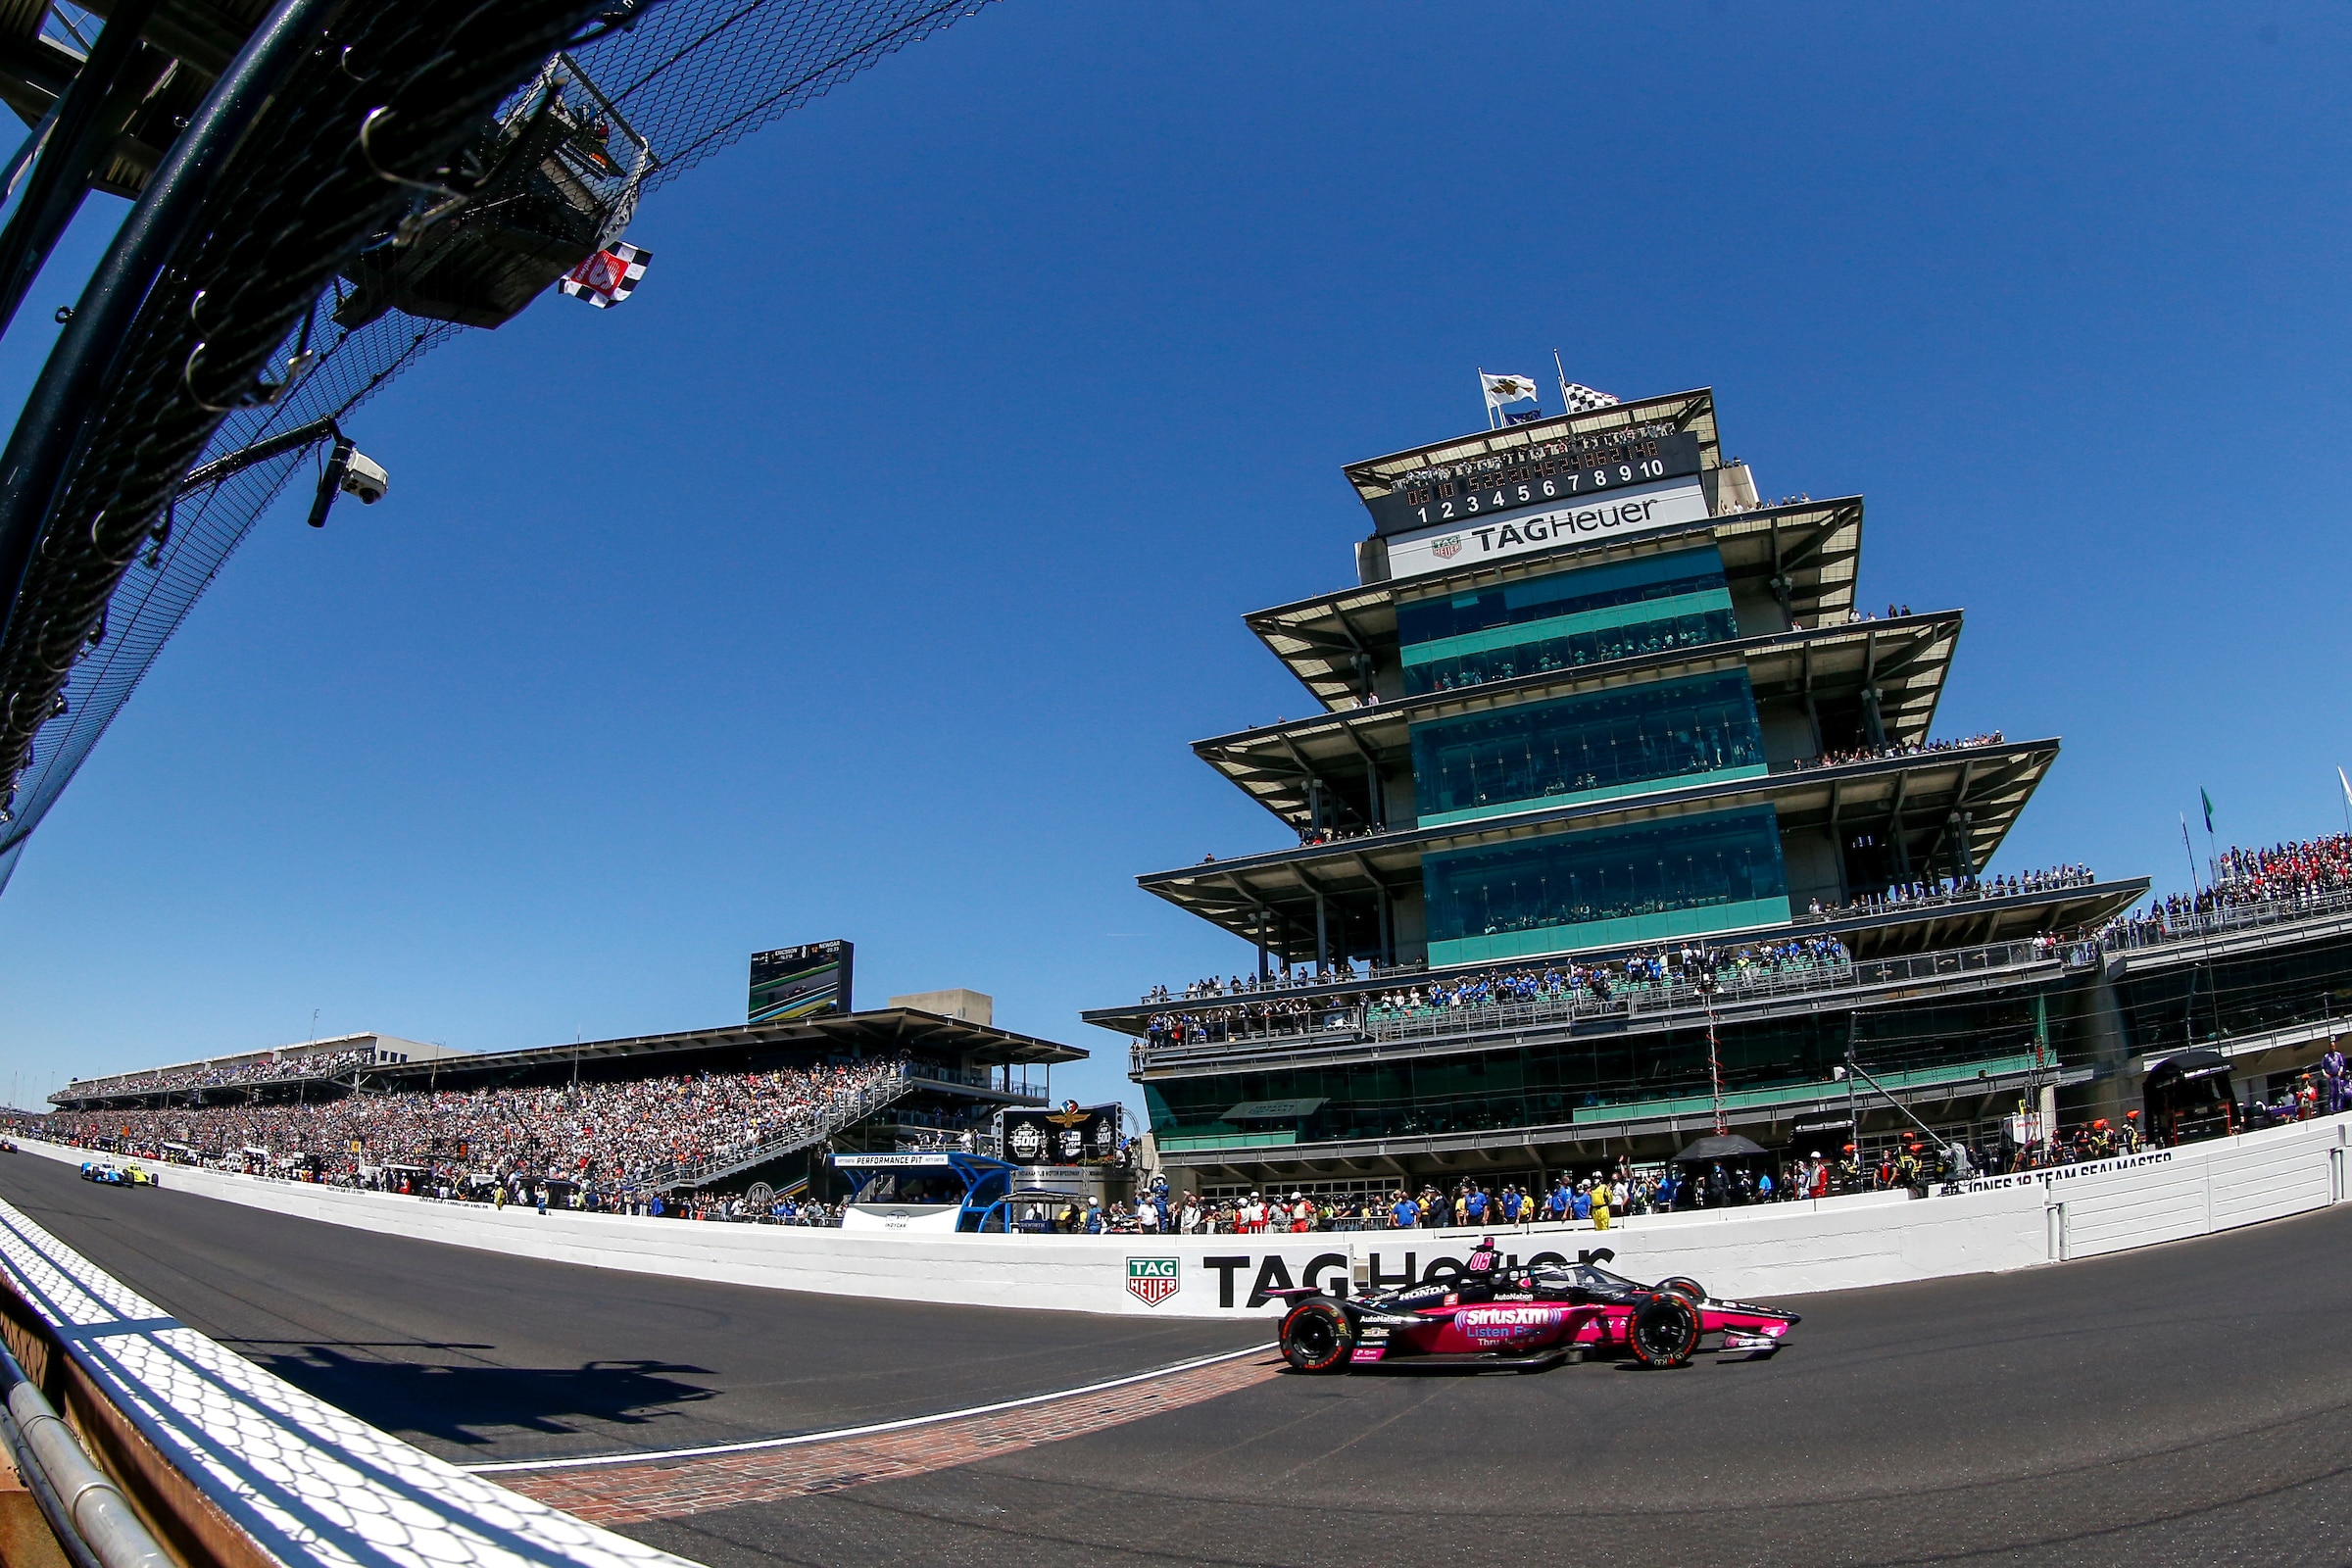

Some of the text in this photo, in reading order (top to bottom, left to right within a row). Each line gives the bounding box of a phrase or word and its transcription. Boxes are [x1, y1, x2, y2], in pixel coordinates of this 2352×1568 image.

[1407, 488, 1430, 506] 06
[1439, 482, 1455, 499] 10
[1507, 466, 1531, 483] 20
[1417, 460, 1663, 523] 1 2 3 4 5 6 7 8 9 10
[1012, 1136, 1039, 1147] 500
[1098, 1133, 1110, 1144] 500
[910, 1155, 922, 1164] PIT
[1132, 1260, 1174, 1276] TAG
[1470, 1251, 1493, 1271] 06
[1130, 1278, 1177, 1303] HEUER
[1398, 1284, 1450, 1301] HONDA
[1494, 1293, 1534, 1301] AutoNation
[1467, 1326, 1508, 1337] Listen
